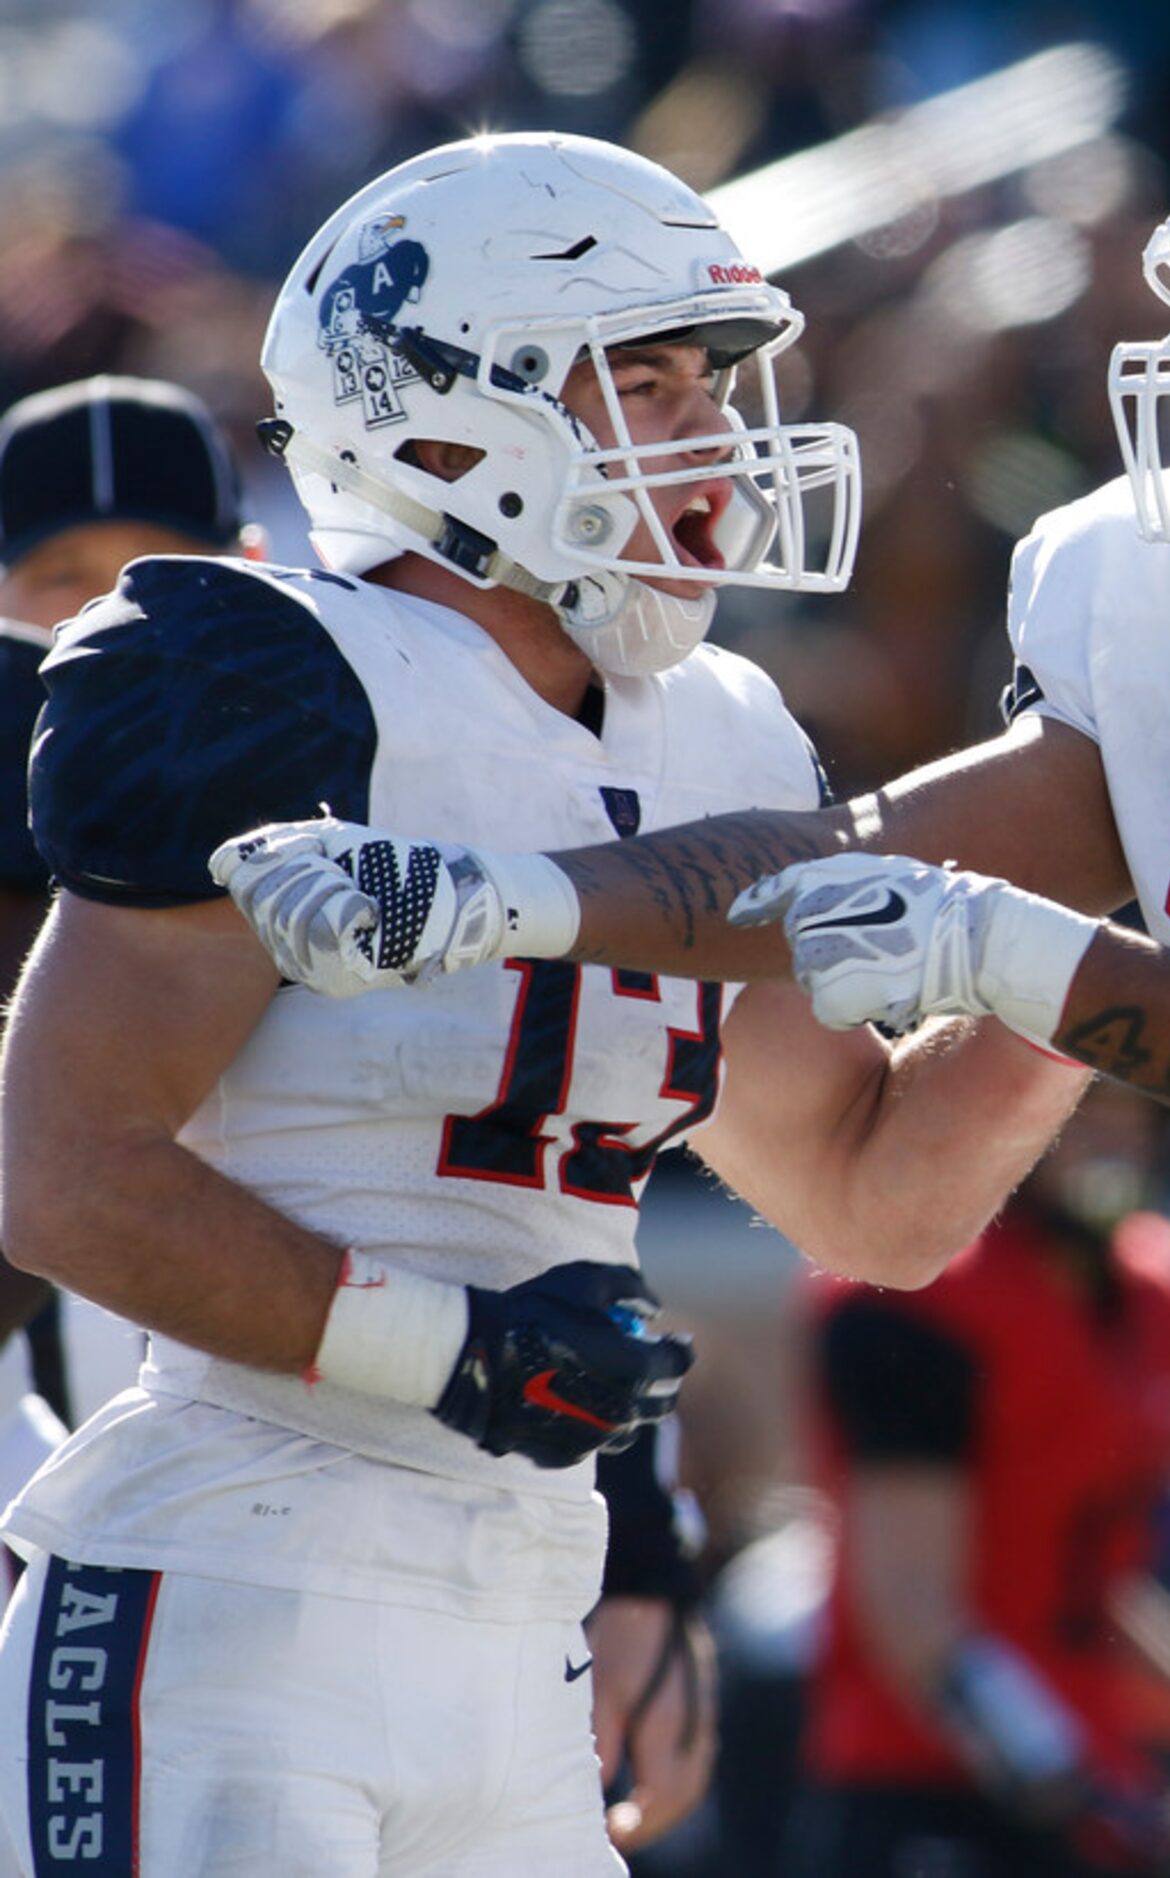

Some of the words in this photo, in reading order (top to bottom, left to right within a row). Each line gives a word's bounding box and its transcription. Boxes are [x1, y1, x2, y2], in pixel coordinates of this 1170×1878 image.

[372, 262, 394, 295] A
[340, 372, 358, 395] 13
[369, 390, 394, 417] 14
[437, 957, 724, 1210] 13
[46, 1563, 118, 1859] AGLES
